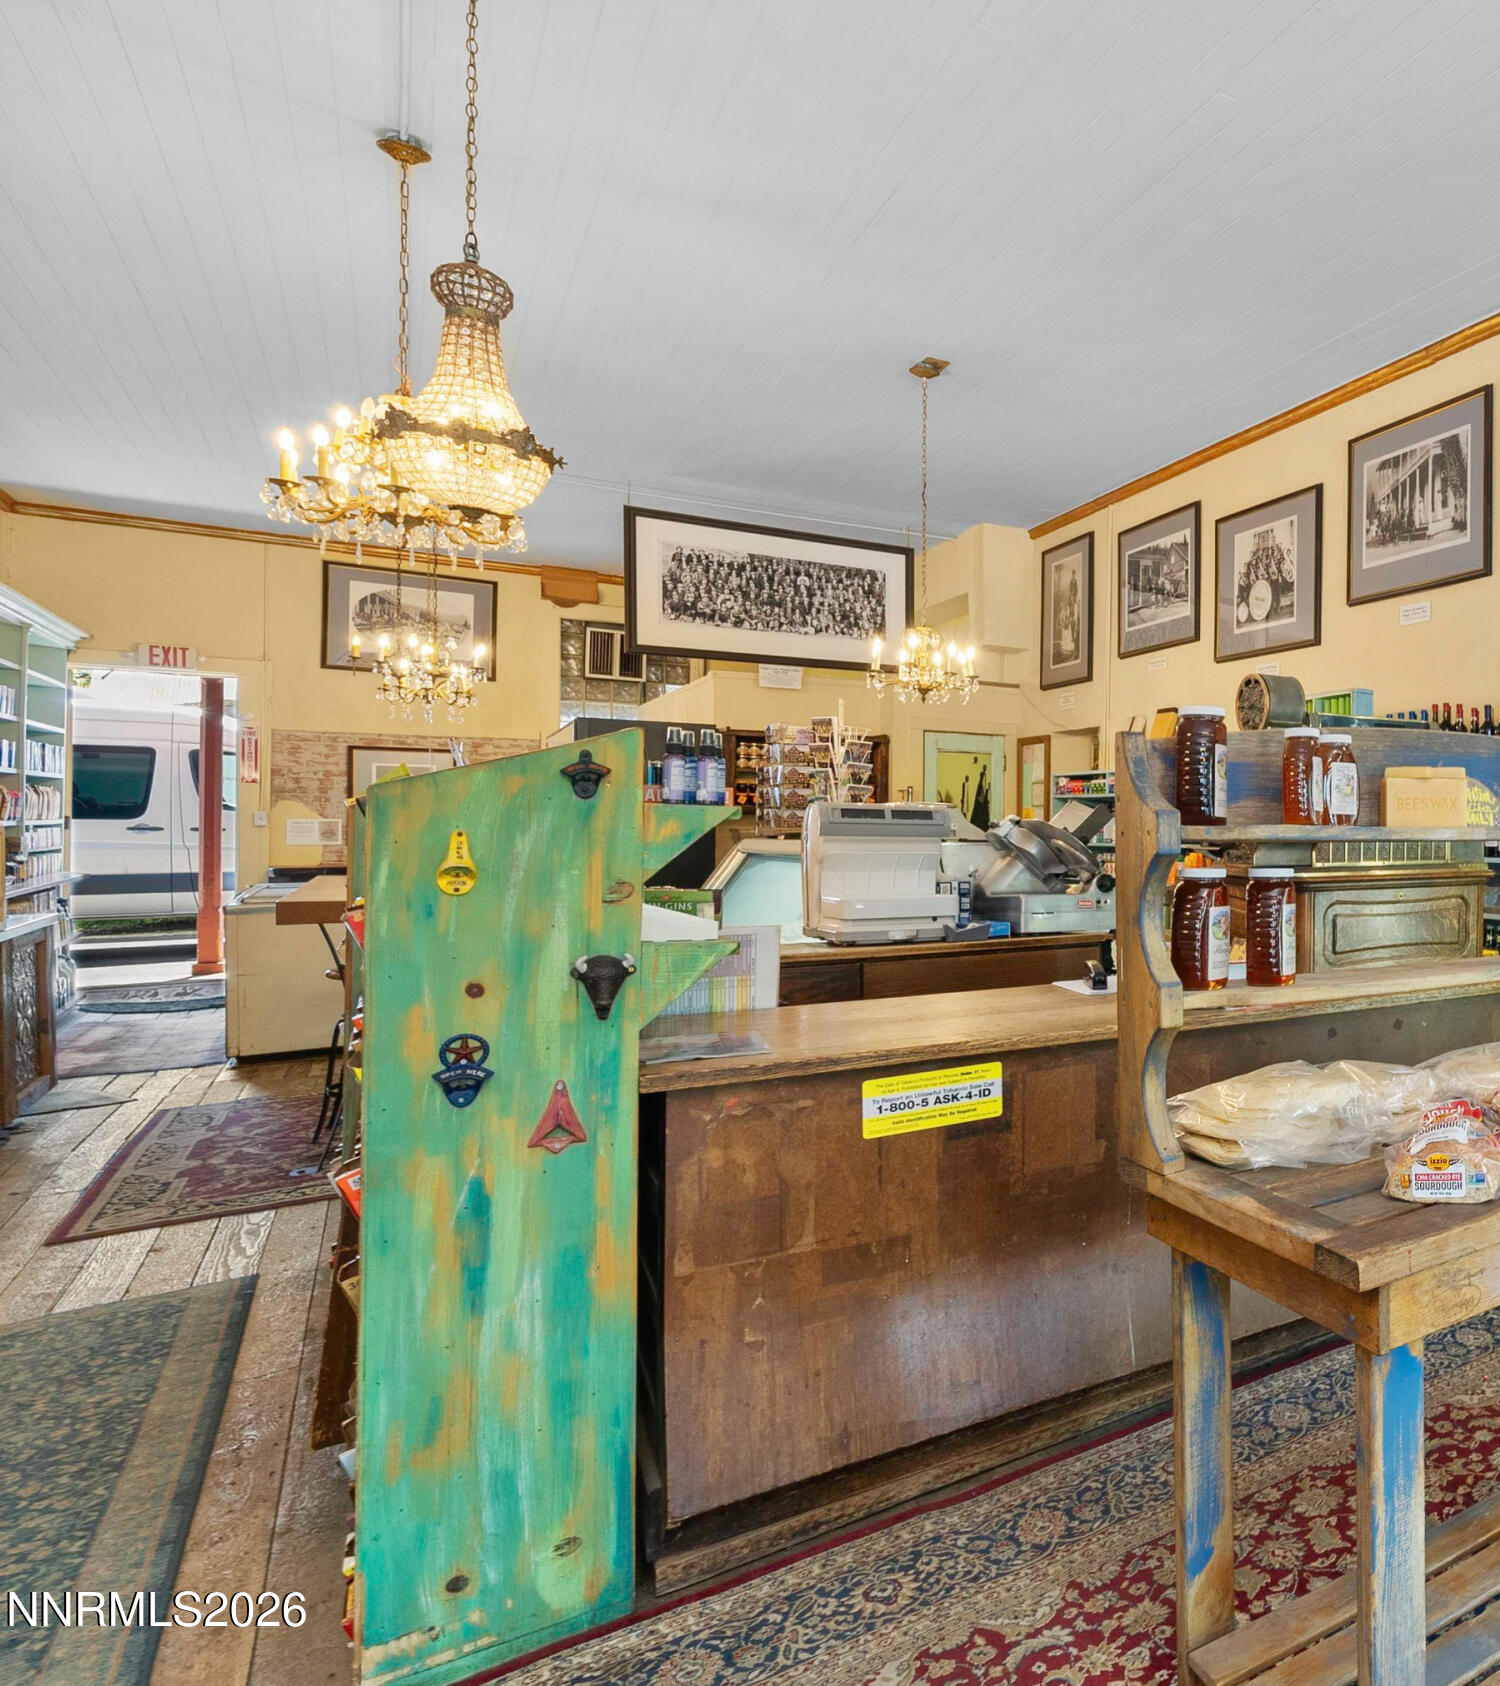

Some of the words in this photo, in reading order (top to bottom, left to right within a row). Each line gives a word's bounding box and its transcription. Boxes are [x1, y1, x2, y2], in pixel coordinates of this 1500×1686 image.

[149, 645, 189, 668] EXIT
[1397, 797, 1458, 811] BEESWAX
[440, 1069, 462, 1079] OPEN
[466, 1069, 487, 1078] HERE
[881, 1095, 904, 1103] Report
[914, 1089, 941, 1099] Unlawful
[983, 1080, 995, 1088] Call
[876, 1097, 930, 1115] 1-800-5
[933, 1087, 992, 1106] ASK-4-ID
[1414, 1181, 1463, 1191] SOURDOUGH
